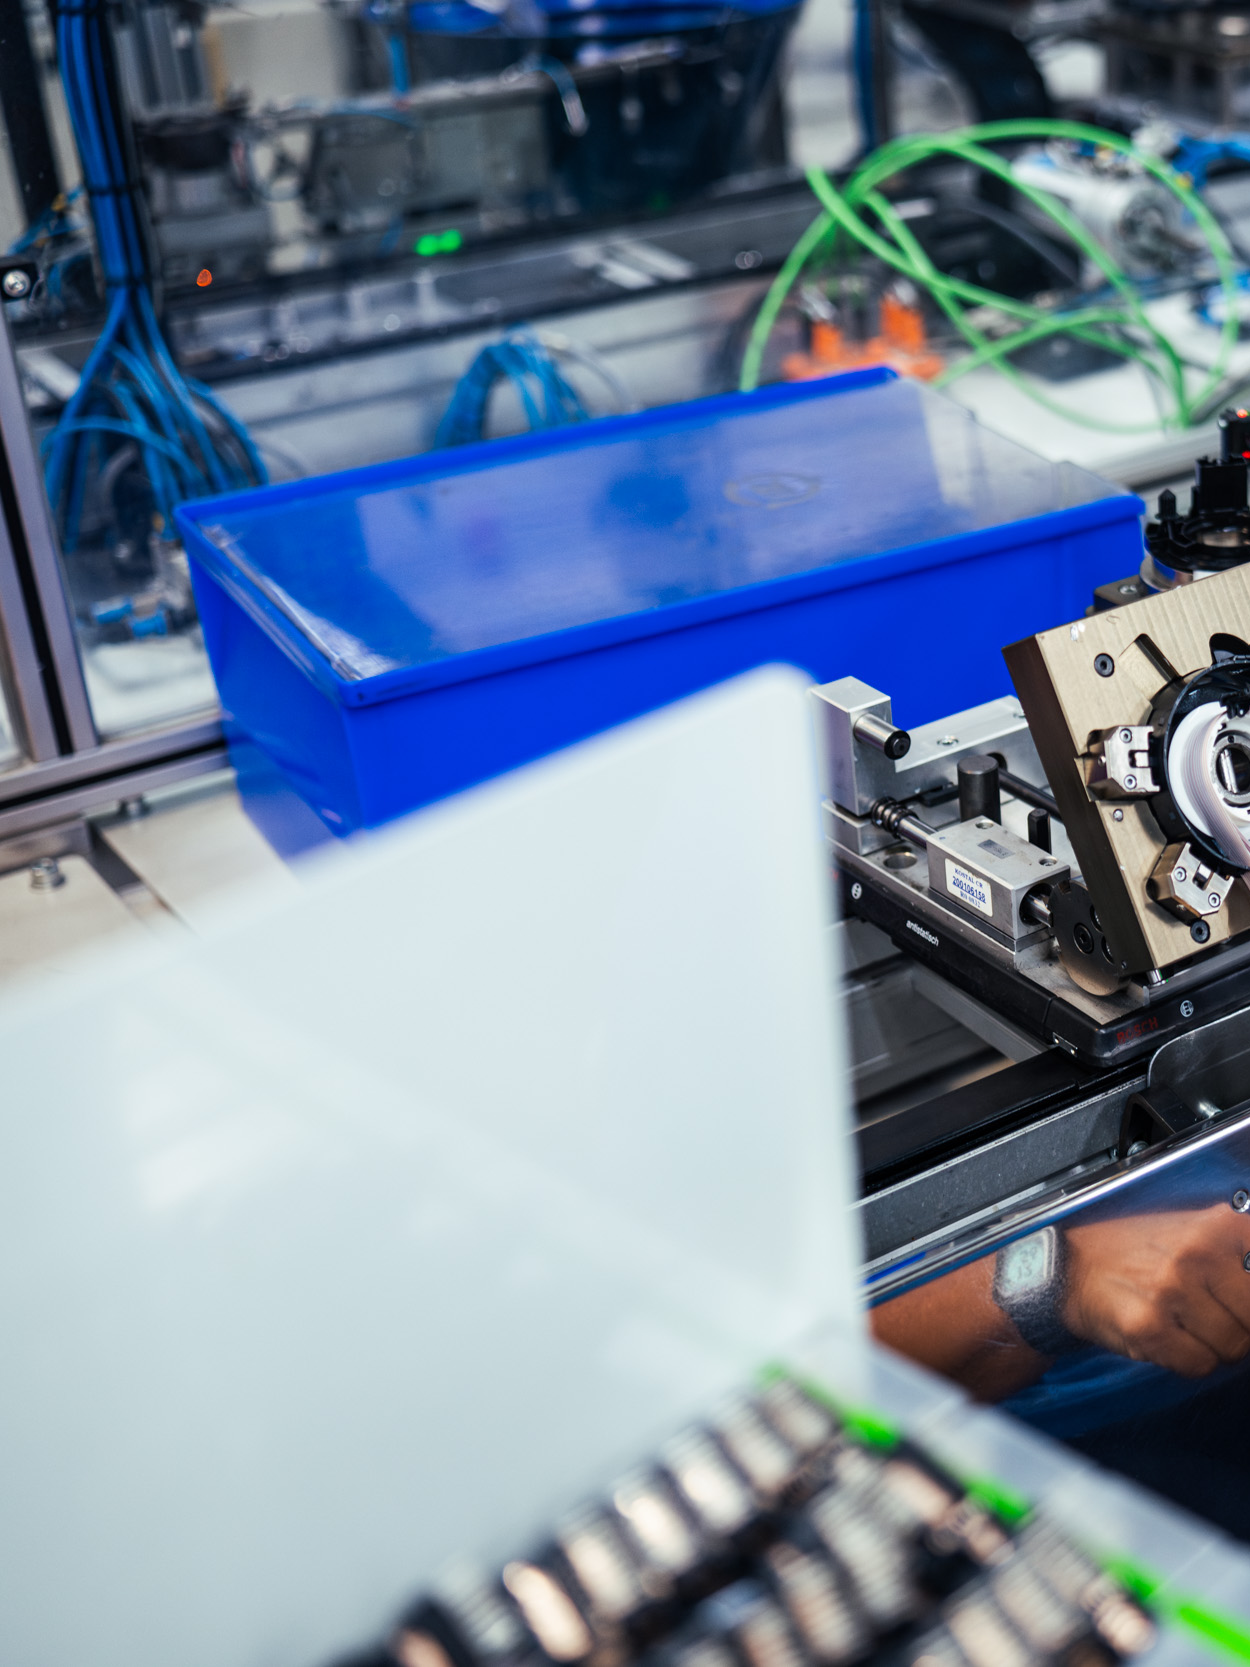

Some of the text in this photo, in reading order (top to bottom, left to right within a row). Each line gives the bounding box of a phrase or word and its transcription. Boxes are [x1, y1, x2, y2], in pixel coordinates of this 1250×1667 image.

[954, 868, 975, 884] KOSTAL
[906, 920, 939, 946] antistatisch
[1116, 1016, 1158, 1044] BOSCH
